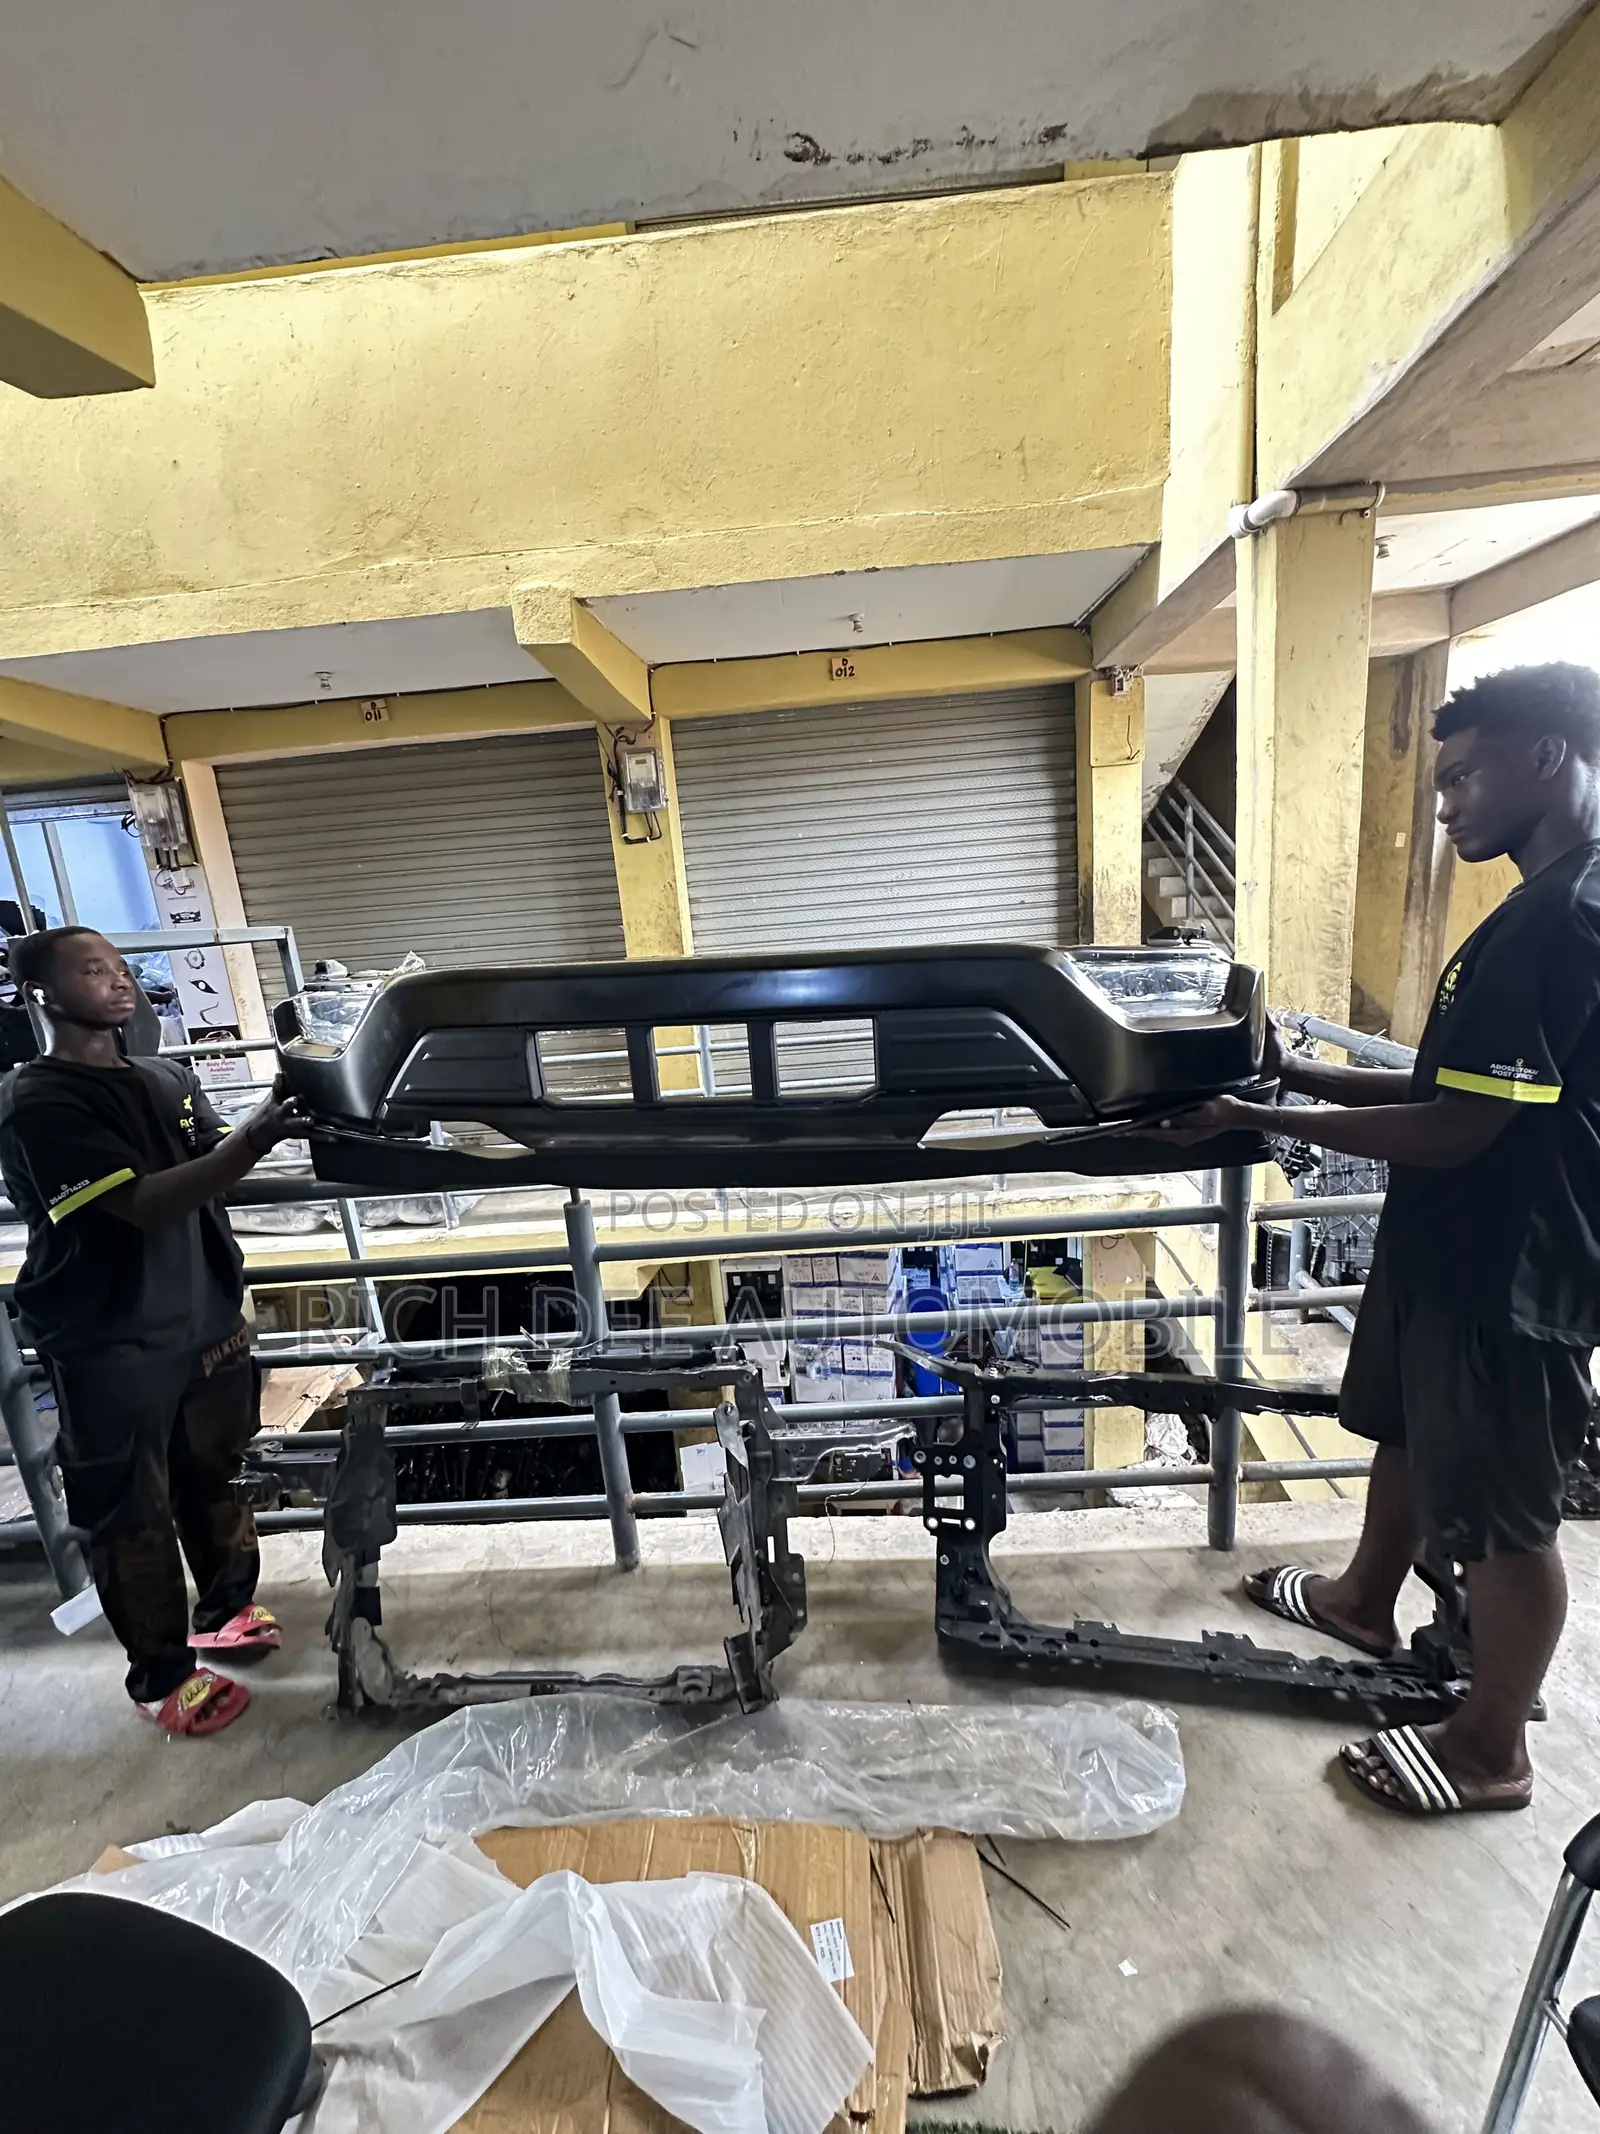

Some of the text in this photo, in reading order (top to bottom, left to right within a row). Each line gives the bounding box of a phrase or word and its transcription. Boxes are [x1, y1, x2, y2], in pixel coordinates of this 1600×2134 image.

[835, 665, 856, 678] 012
[365, 709, 382, 722] 011
[1491, 1069, 1512, 1078] POST
